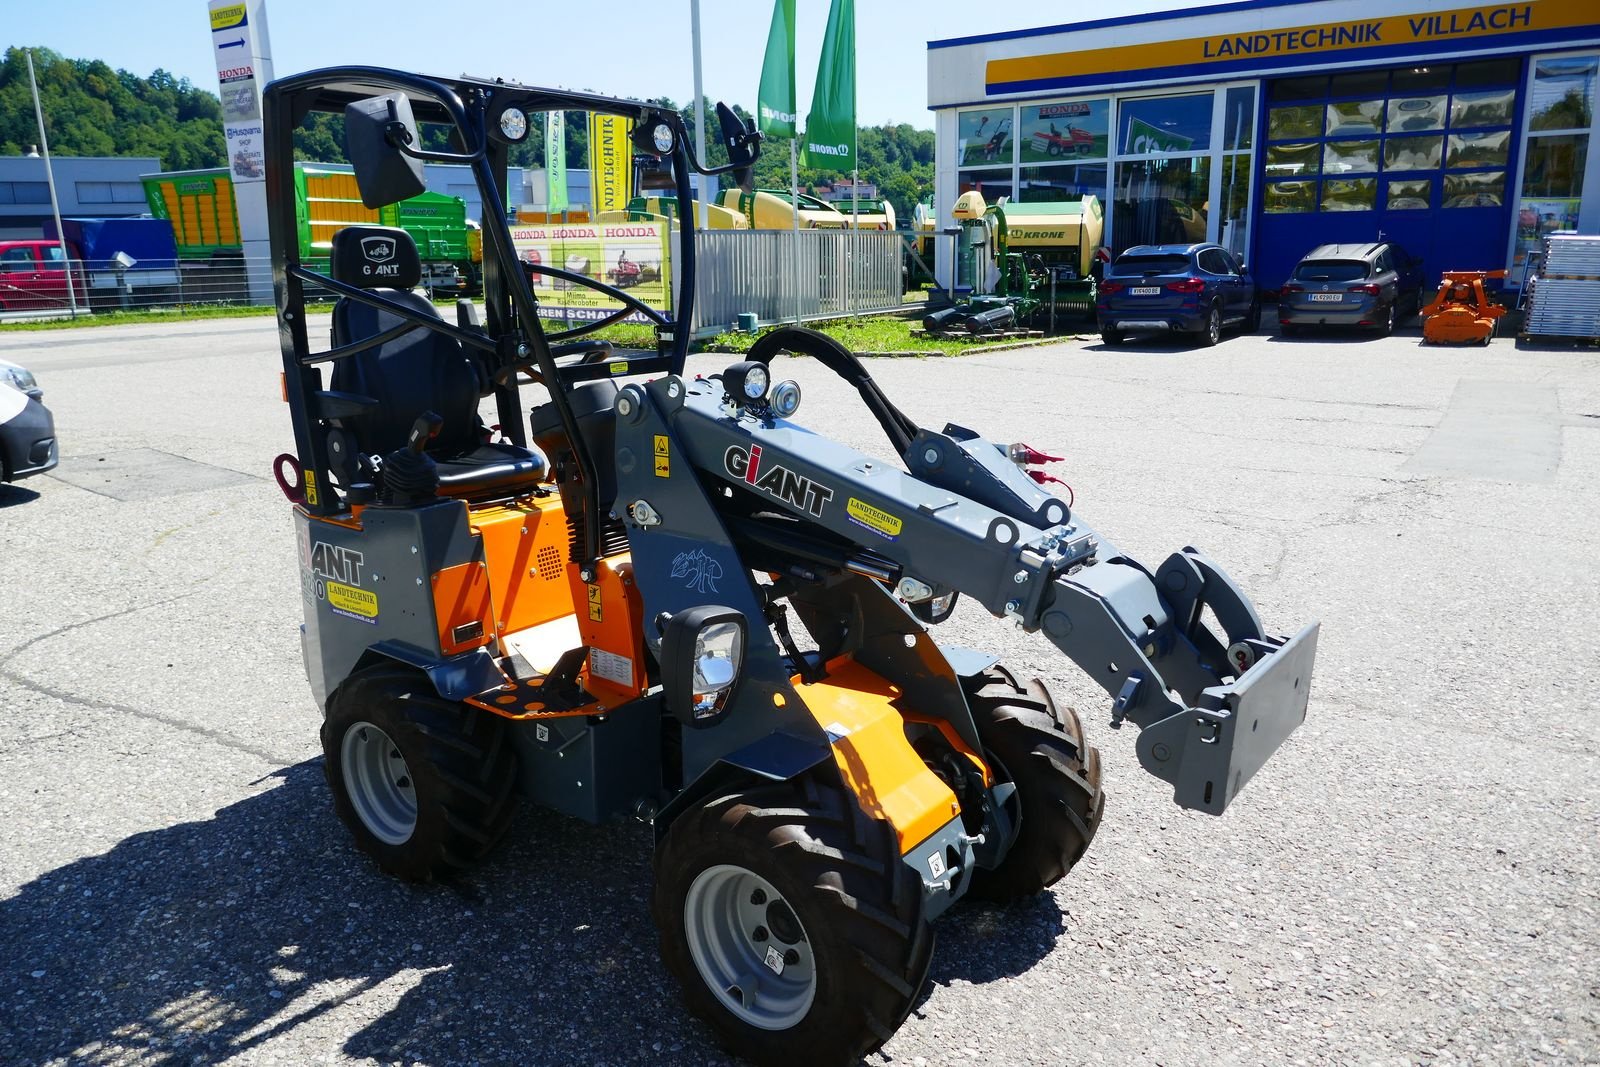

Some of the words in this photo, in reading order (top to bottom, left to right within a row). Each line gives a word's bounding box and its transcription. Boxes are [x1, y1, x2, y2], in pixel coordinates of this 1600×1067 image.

[1202, 22, 1382, 58] LANDTECHNIK
[1408, 6, 1532, 37] VILLACH
[219, 66, 253, 79] HONDA
[1039, 103, 1090, 116] HONDA
[514, 230, 547, 240] HONDA
[552, 228, 597, 239] HONDA
[605, 227, 657, 238] HONDA
[1024, 231, 1066, 239] KRONE
[363, 264, 399, 275] GANT
[566, 291, 586, 299] Miimo
[557, 299, 598, 307] Rasenroboter
[850, 499, 899, 527] LANDTECHNIK
[329, 584, 375, 604] LANDTECHNIK
